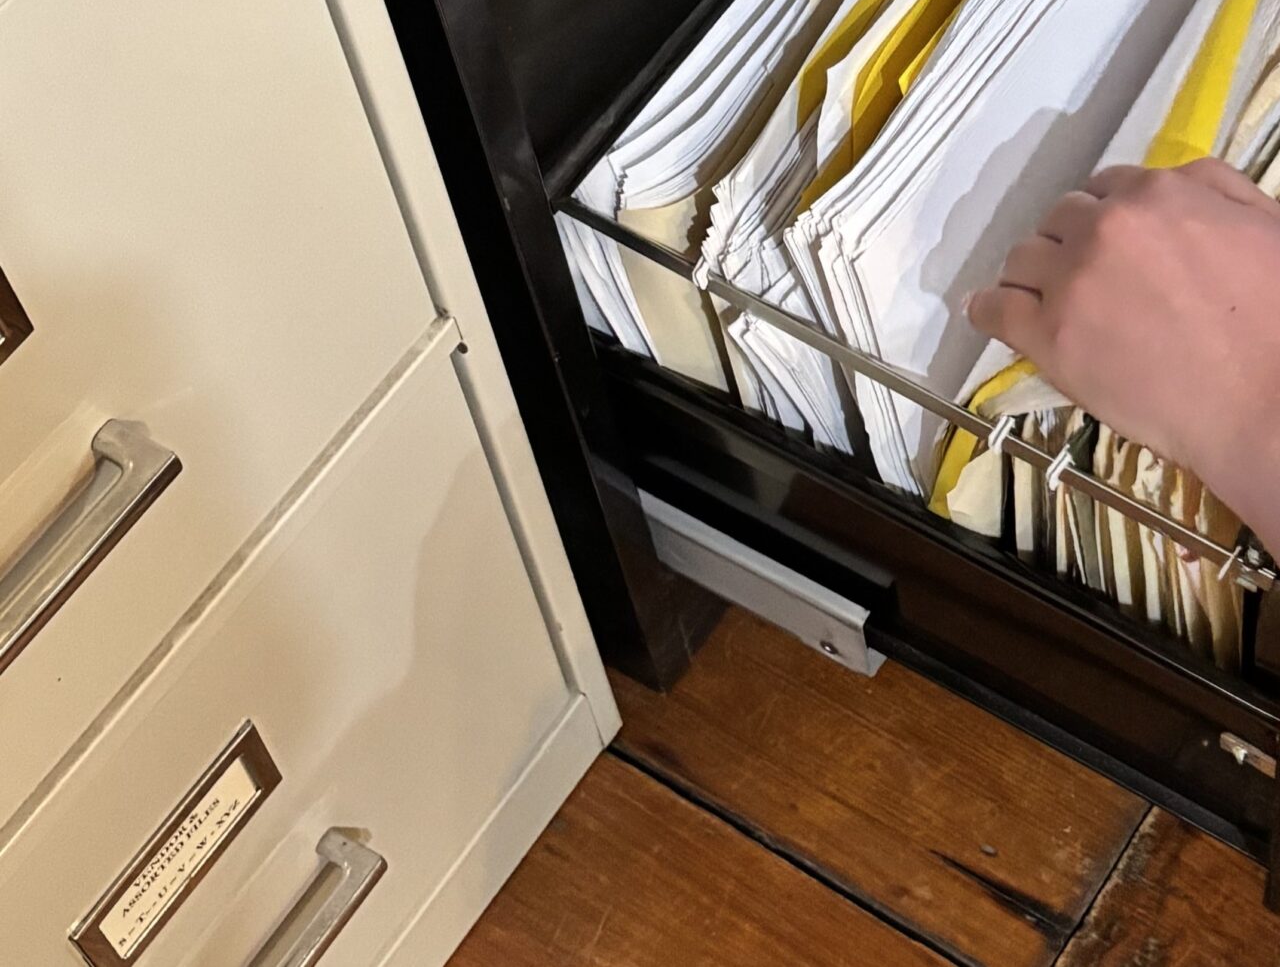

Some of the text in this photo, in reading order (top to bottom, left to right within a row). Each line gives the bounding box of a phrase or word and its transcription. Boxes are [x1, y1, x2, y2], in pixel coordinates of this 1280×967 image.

[123, 798, 220, 918] ASSORTED FILES
[134, 812, 198, 887] VENDOR &
[196, 837, 207, 850] W
